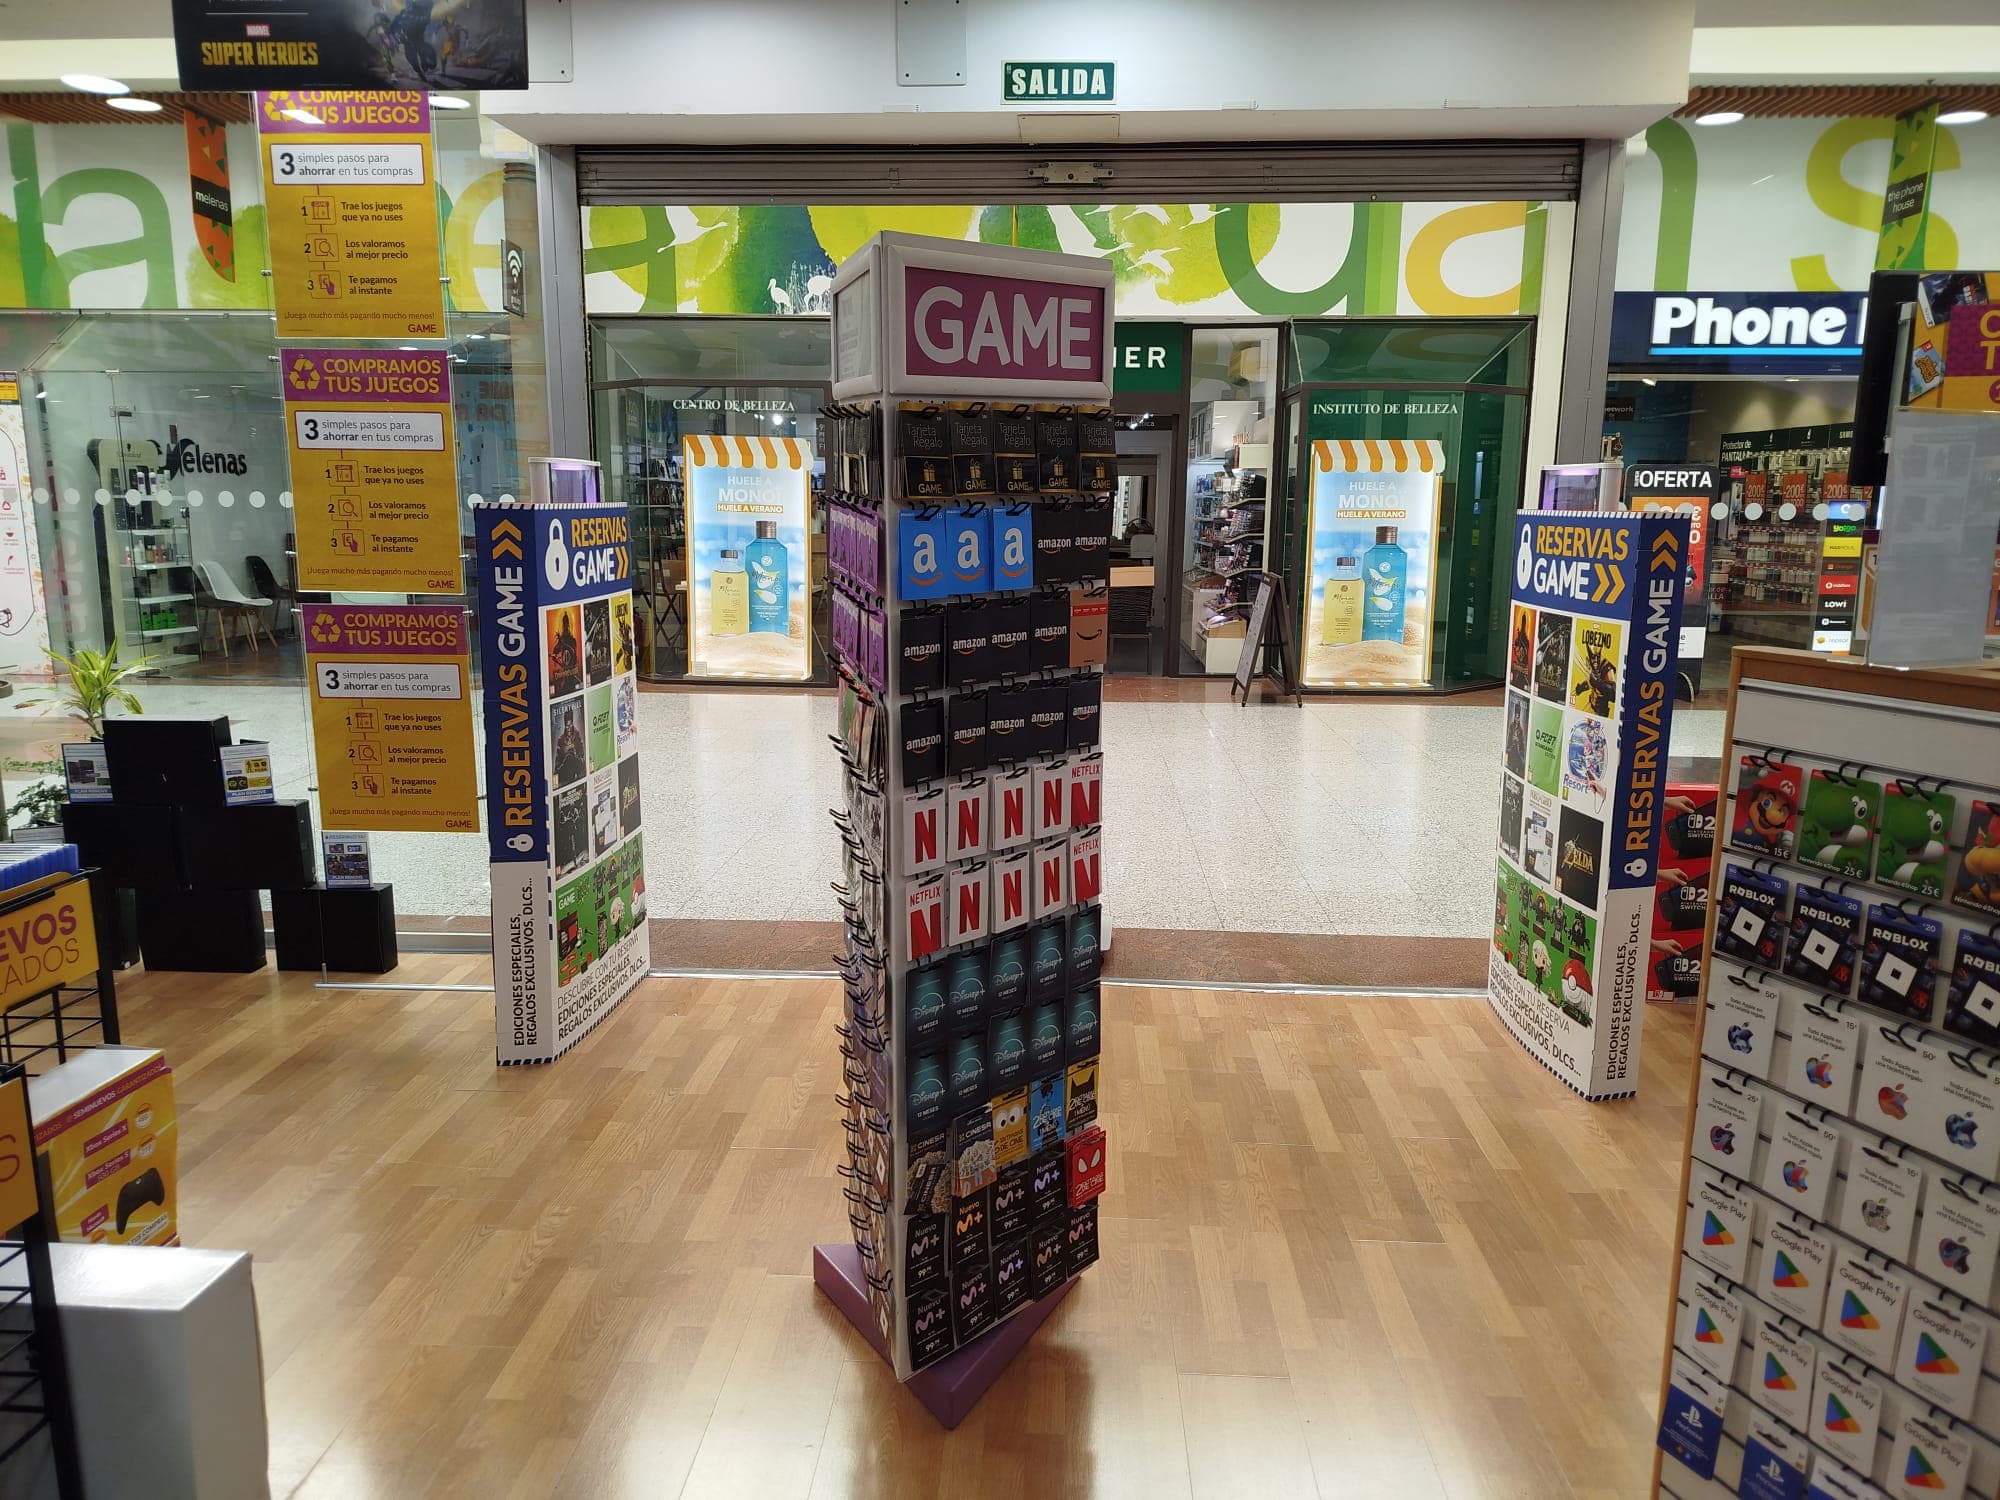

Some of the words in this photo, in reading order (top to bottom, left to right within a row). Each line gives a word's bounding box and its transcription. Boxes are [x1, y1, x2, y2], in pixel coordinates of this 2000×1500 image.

[202, 42, 255, 65] SUPER
[256, 42, 318, 65] HEROES
[1012, 69, 1106, 95] SALIDA
[299, 90, 421, 103] COMPRAMOS
[343, 106, 419, 124] JUEGOS
[280, 153, 295, 175] 3
[298, 153, 334, 162] simples
[368, 155, 389, 163] para
[299, 166, 335, 176] ahorrar
[339, 168, 350, 176] en
[354, 167, 368, 176] tus
[372, 168, 413, 177] compras
[195, 189, 229, 213] melenas
[341, 202, 359, 210] Trae
[361, 202, 373, 210] los
[375, 202, 402, 212] juegos
[301, 206, 308, 216] 1
[304, 243, 311, 253] 2
[346, 240, 360, 248] Los
[362, 240, 405, 248] valoramos
[356, 251, 380, 260] mejor
[382, 251, 408, 260] precio
[308, 280, 314, 290] 3
[360, 276, 397, 285] pagamos
[359, 287, 392, 295] instante
[350, 312, 380, 320] pagando
[1652, 297, 1847, 345] Phone
[408, 324, 436, 333] GAME
[914, 285, 1092, 369] GAME
[323, 359, 441, 375] COMPRAMOS
[324, 377, 361, 393] TUS
[366, 377, 439, 394] JUEGOS
[673, 399, 720, 410] CENTRO
[725, 400, 740, 410] DE
[743, 401, 794, 412] BELLEZA
[1313, 404, 1380, 414] INSTITUTO
[1384, 404, 1400, 414] DE
[1404, 404, 1458, 414] BELLEZA
[304, 419, 319, 440] 3
[322, 420, 357, 430] simples
[360, 421, 387, 430] pasos
[390, 422, 411, 431] para
[907, 424, 936, 437] Tarjeta
[323, 432, 358, 441] ahorrar
[362, 434, 373, 442] en
[376, 433, 390, 442] tus
[394, 434, 433, 444] compras
[913, 437, 942, 448] Regalo
[966, 479, 986, 489] GAME
[1008, 481, 1029, 491] GAME
[1640, 471, 1712, 488] OFERTA
[918, 483, 942, 494] GAME
[571, 517, 627, 547] RESERVAS
[1038, 537, 1071, 548] amazon
[1075, 535, 1107, 546] amazon
[1537, 525, 1629, 560] RESERVAS
[573, 546, 615, 587] GAME
[427, 580, 454, 588] GAME
[1534, 558, 1590, 600] GAME
[495, 566, 526, 657] GAME
[344, 613, 458, 629] COMPRAMOS
[1643, 579, 1674, 673] GAME
[344, 630, 381, 645] TUS
[385, 630, 457, 646] JUEGOS
[992, 631, 1027, 643] amazon
[1035, 626, 1067, 637] amazon
[953, 637, 986, 649] amazon
[1581, 630, 1611, 650] LOBEZNO
[904, 643, 940, 657] amazon
[325, 670, 340, 689] 3
[343, 671, 376, 680] simples
[379, 672, 406, 681] pasos
[408, 672, 428, 681] para
[344, 682, 378, 691] ahorrar
[381, 683, 392, 691] en
[395, 683, 409, 691] tus
[412, 683, 450, 693] compras
[990, 718, 1024, 730] amazon
[1032, 712, 1064, 723] amazon
[499, 663, 534, 827] RESERVAS
[1072, 764, 1100, 778] NETFLIX
[1625, 681, 1666, 852] RESERVAS
[1563, 774, 1590, 794] Resort
[446, 820, 472, 828] GAME
[1074, 839, 1099, 855] NETFLIX
[1566, 849, 1593, 872] ZELDA
[1799, 856, 1822, 868] Nintendo
[910, 886, 941, 907] NETFLIX
[1729, 885, 1775, 906] ROBLOX
[1800, 905, 1851, 928] ROBLOX
[1872, 928, 1928, 951] ROBLOX
[511, 913, 522, 983] ESPECIALES,
[524, 918, 535, 991] EXCLUSIVOS,
[1612, 942, 1628, 1014] ESPECIALES,
[1622, 946, 1638, 1022] EXCLUSIVOS,
[513, 985, 524, 1045] EDICIONES
[526, 994, 536, 1045] REGALOS
[559, 1005, 592, 1041] REGALOS
[1537, 1000, 1570, 1034] RESERVA
[1509, 1005, 1550, 1054] EXCLUSIVOS,
[1607, 1017, 1620, 1080] EDICIONES
[1618, 1026, 1630, 1079] REGALOS
[1036, 1160, 1056, 1174] Nuevo
[960, 1201, 980, 1215] Nuevo
[915, 1224, 936, 1238] Nuevo
[1771, 1229, 1800, 1251] Google
[1804, 1246, 1823, 1264] Play
[1840, 1267, 1874, 1292] Google
[1876, 1289, 1896, 1306] Play
